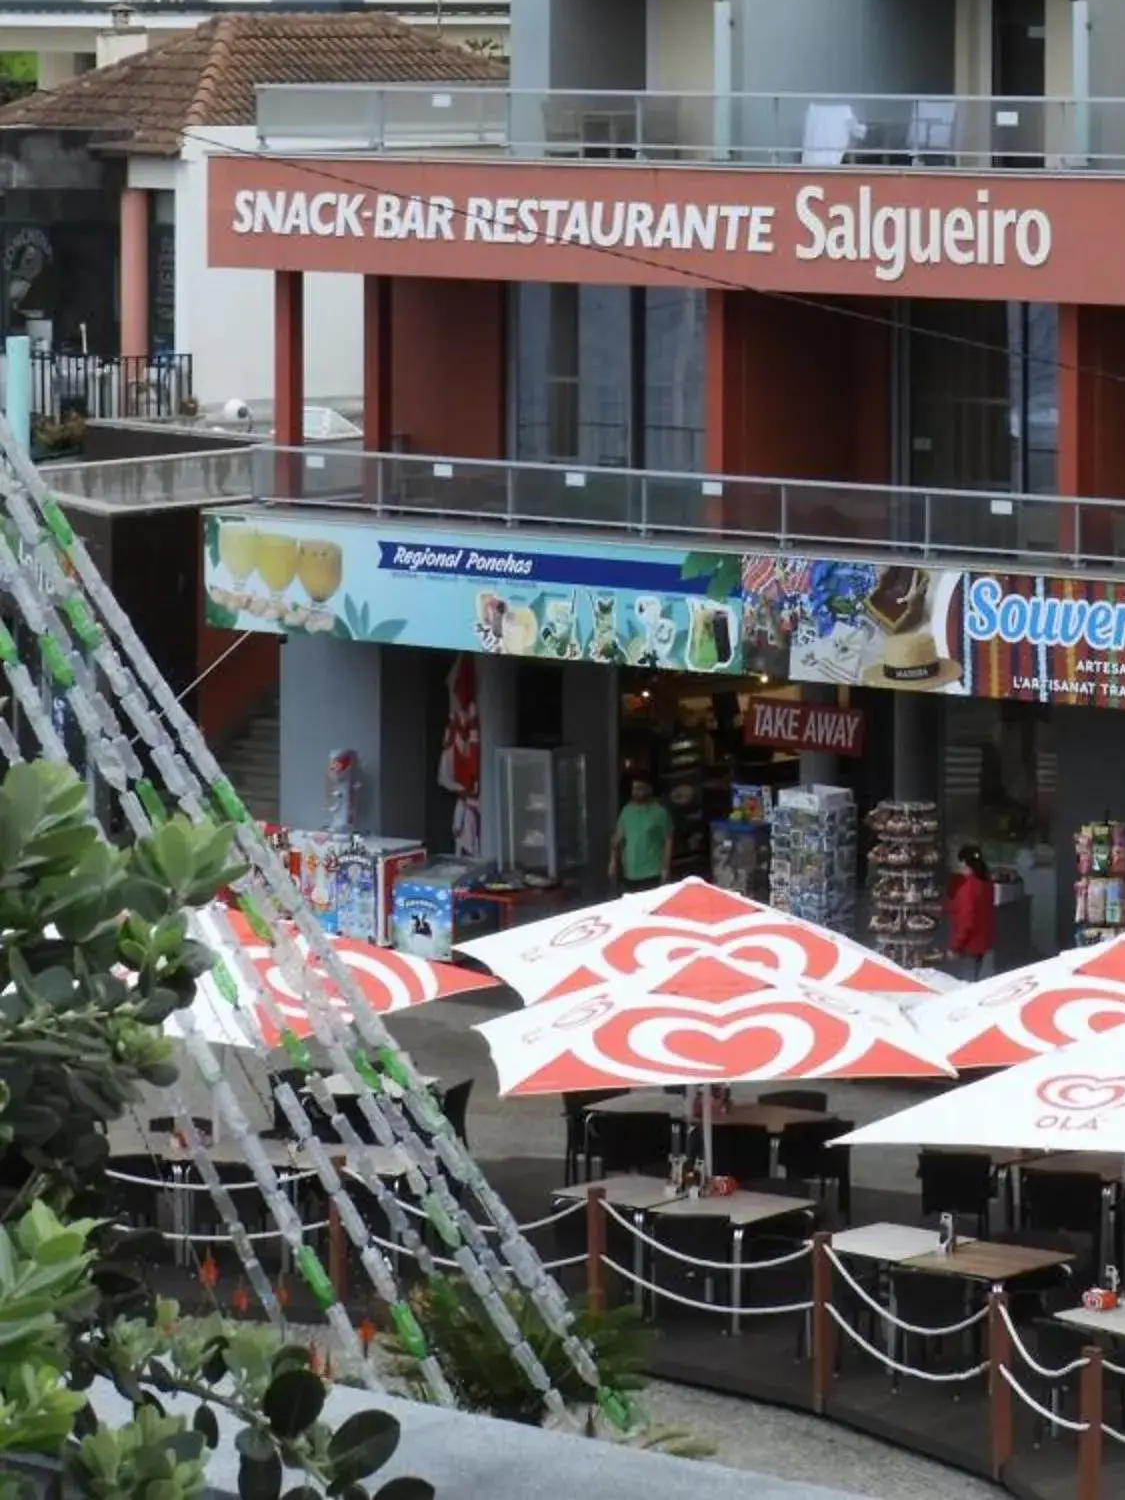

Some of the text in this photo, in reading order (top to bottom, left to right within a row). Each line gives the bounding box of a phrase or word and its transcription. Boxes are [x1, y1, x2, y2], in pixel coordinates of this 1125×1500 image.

[232, 185, 1052, 282] SNACK-BAR RESTAURANTE Salgueiro
[393, 546, 464, 572] Regional
[1013, 675, 1096, 695] L'ARTISANAT
[753, 703, 861, 749] TAKE AWAY
